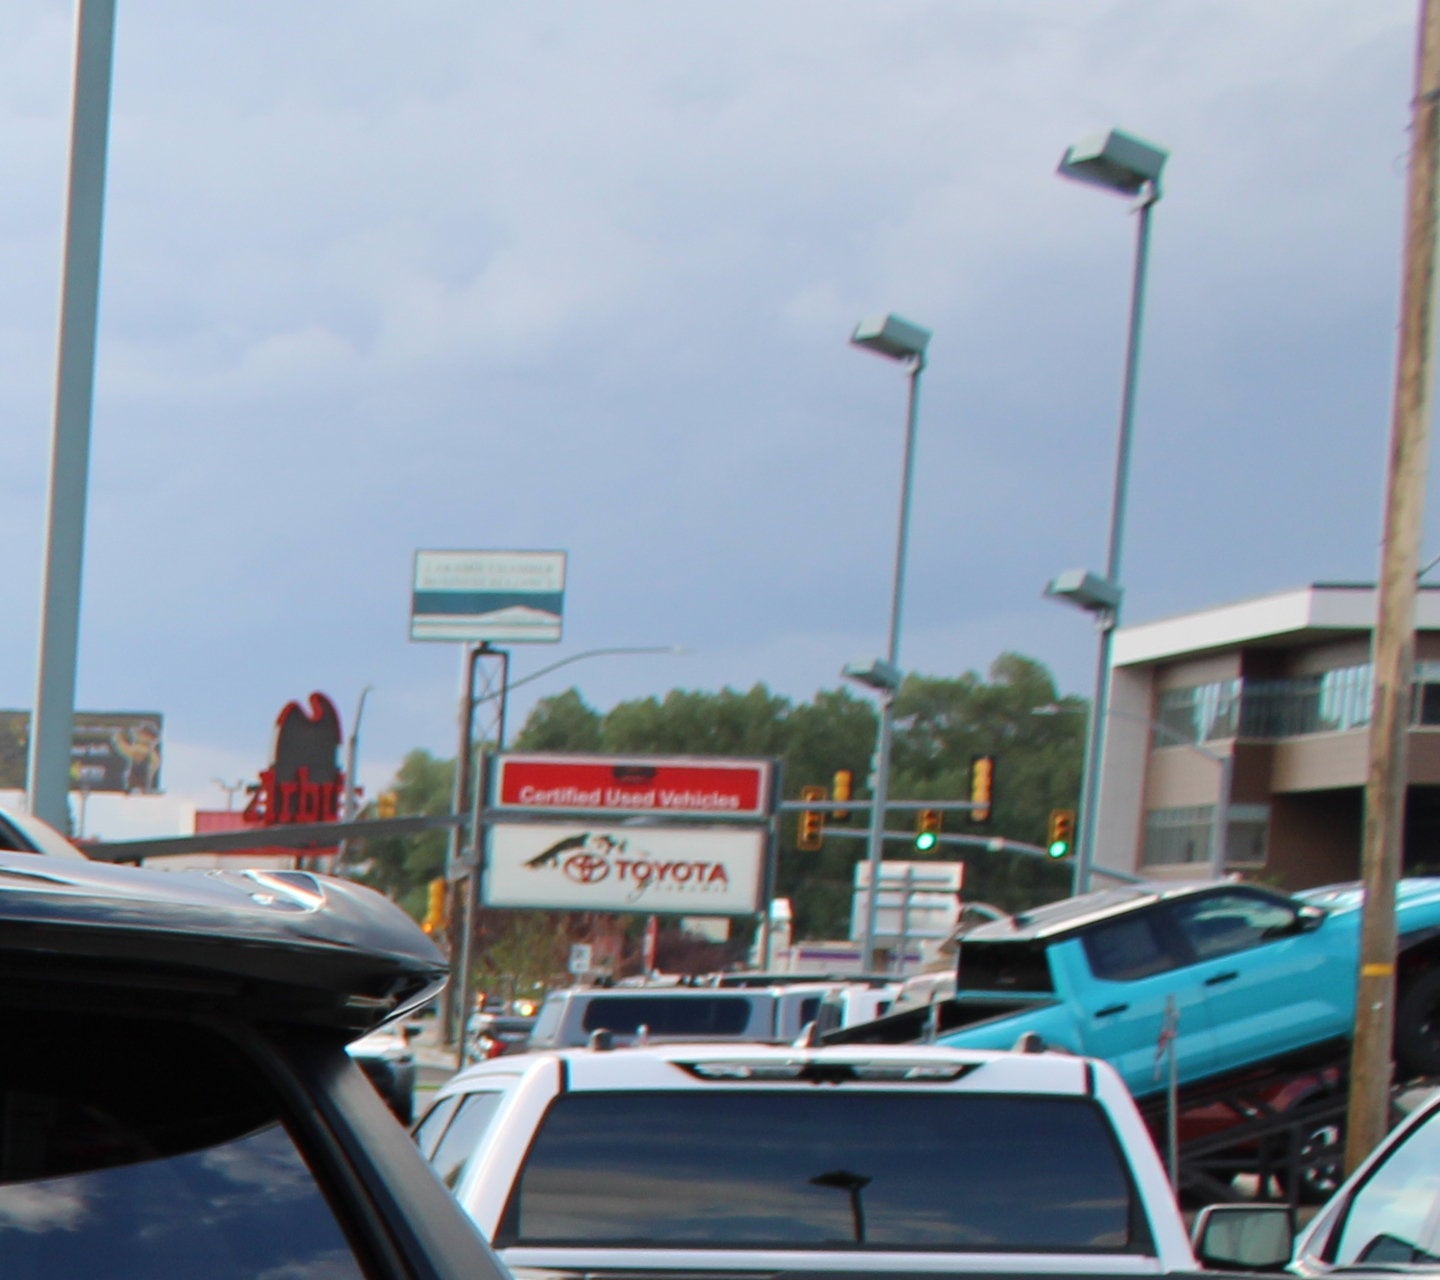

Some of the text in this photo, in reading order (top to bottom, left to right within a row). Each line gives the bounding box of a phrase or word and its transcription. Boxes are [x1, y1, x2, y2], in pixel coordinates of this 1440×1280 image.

[518, 785, 740, 810] Certified Used Vehicles
[615, 859, 728, 885] TOYOTA
